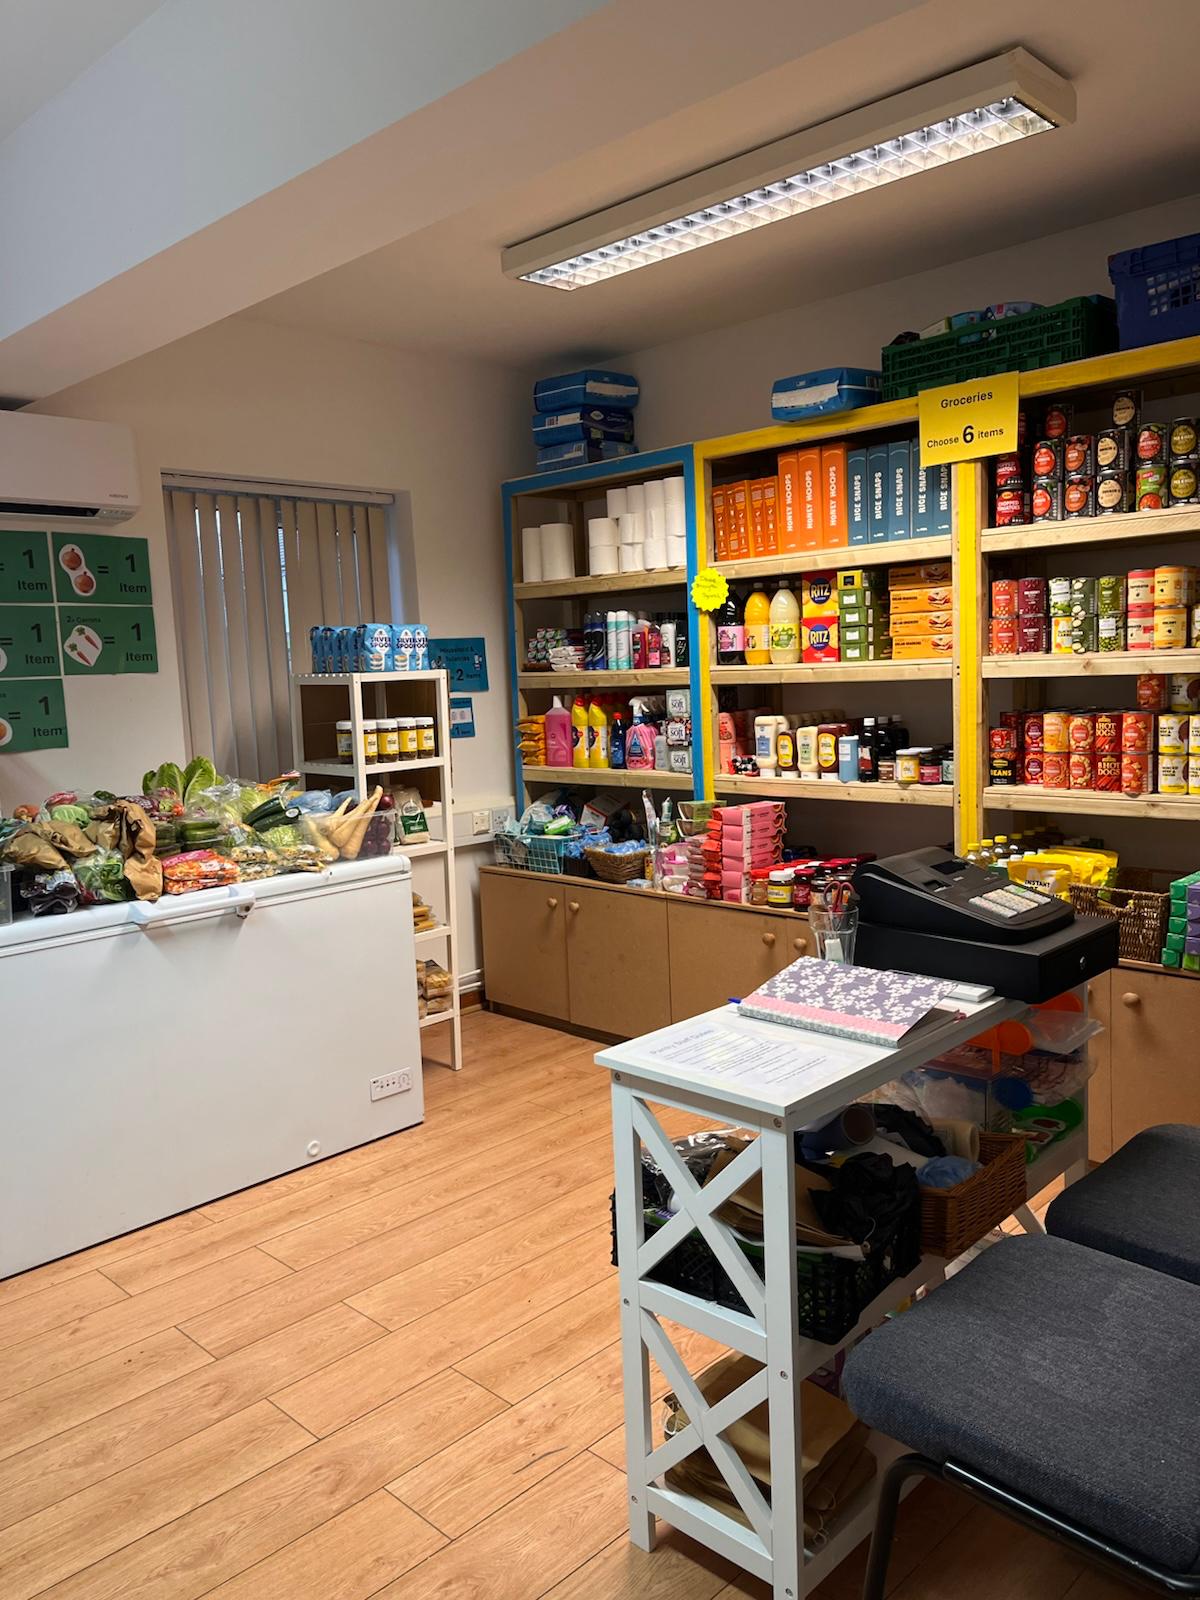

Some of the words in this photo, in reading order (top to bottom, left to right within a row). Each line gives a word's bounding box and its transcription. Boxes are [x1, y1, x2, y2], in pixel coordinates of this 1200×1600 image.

[941, 392, 993, 409] Groceries
[927, 437, 959, 448] Choose
[963, 425, 974, 444] 6
[978, 428, 1004, 439] items
[918, 494, 926, 513] RICE
[940, 491, 948, 511] RICE
[22, 549, 34, 569] 1
[125, 554, 136, 572] 1
[18, 580, 47, 591] Item
[120, 583, 147, 593] Item
[811, 584, 830, 598] RITZ
[31, 624, 42, 643] 1
[131, 623, 141, 641] 1
[810, 630, 829, 644] RITZ
[25, 654, 55, 665] Item
[126, 652, 153, 662] Item
[456, 669, 463, 681] 2
[38, 696, 49, 715] 1
[33, 727, 63, 738] Item
[1100, 722, 1117, 730] HOT
[1098, 768, 1120, 776] DOGS
[1102, 761, 1120, 769] HOT
